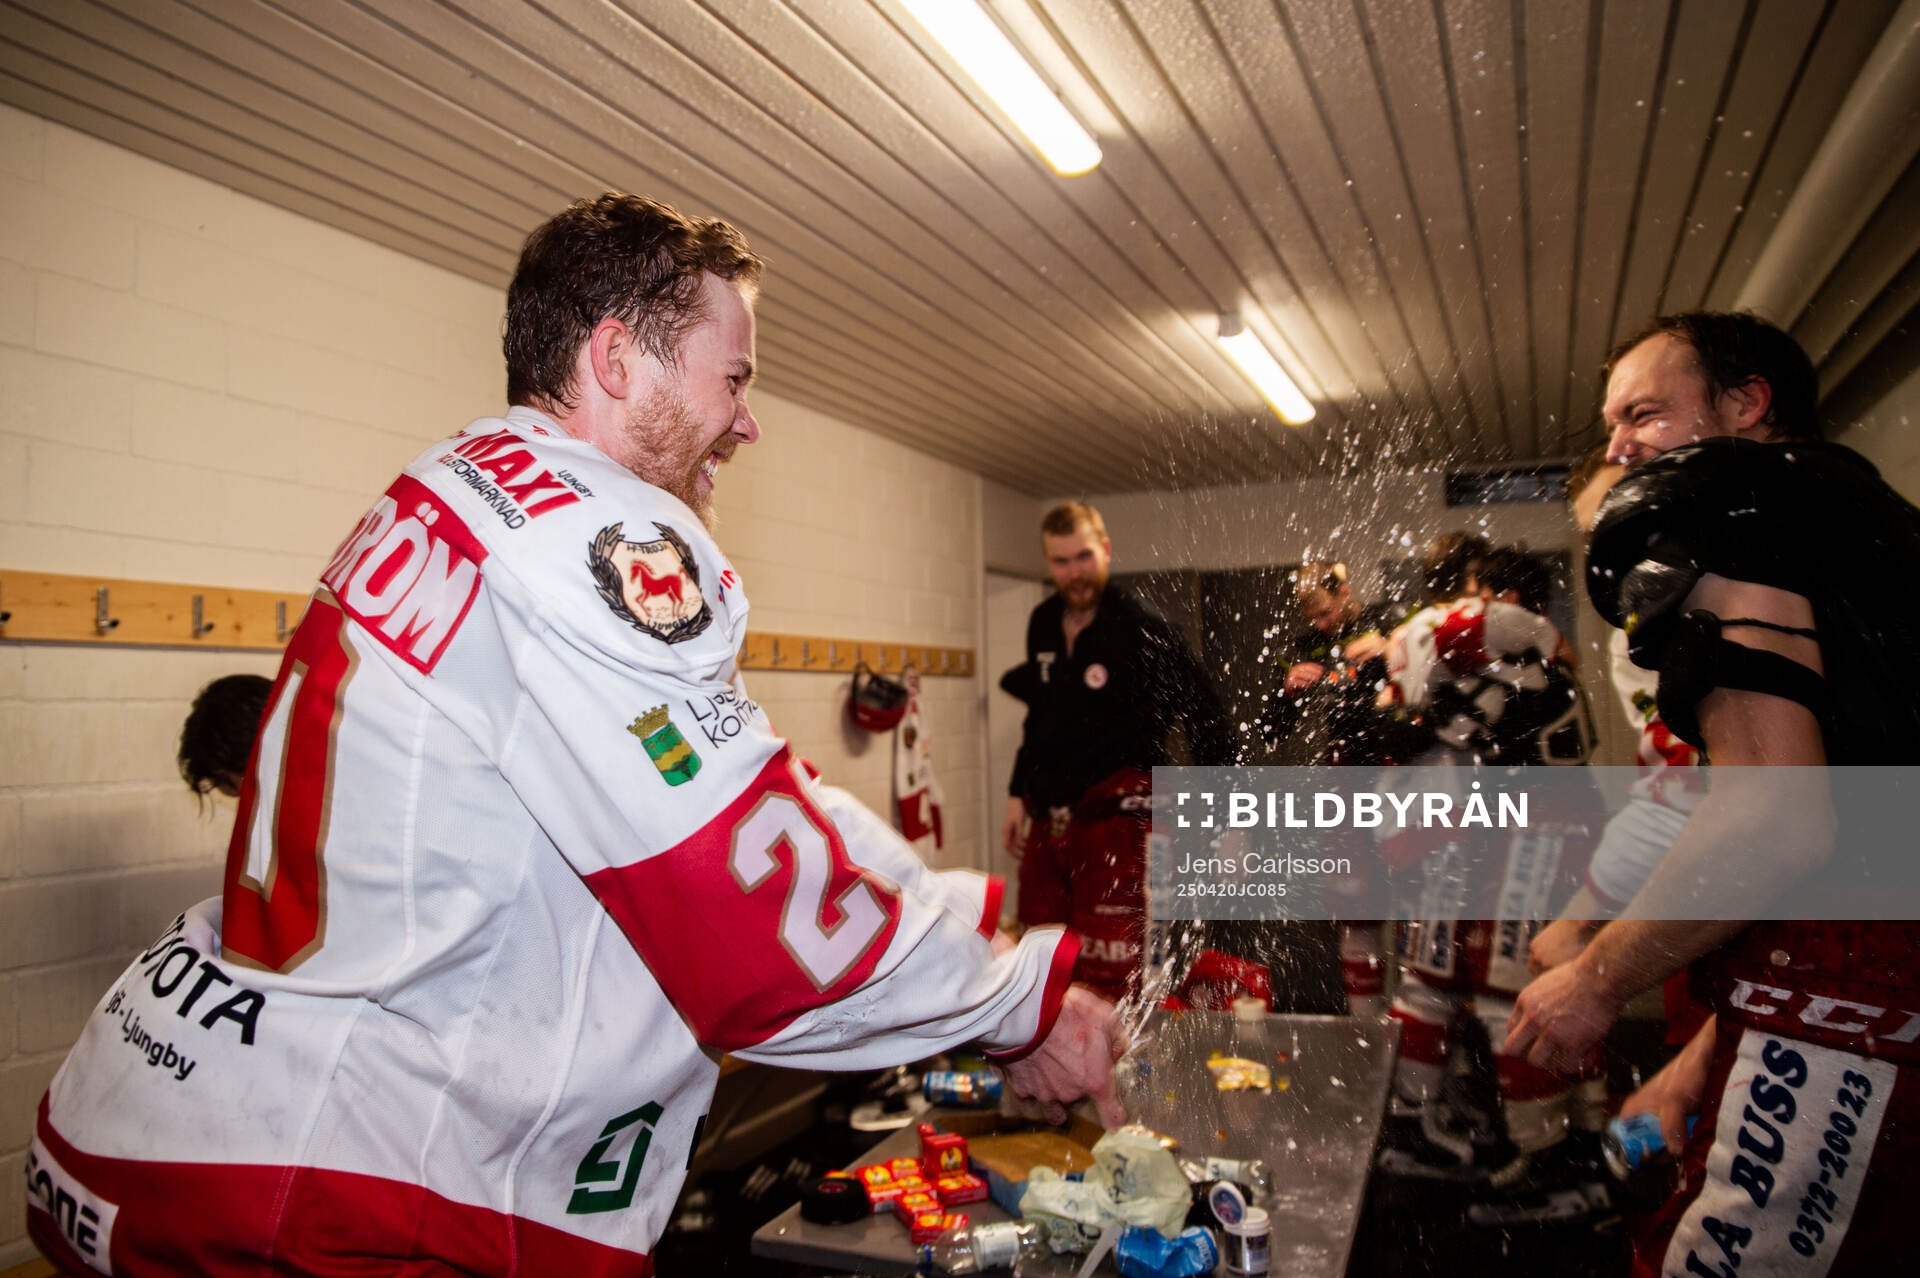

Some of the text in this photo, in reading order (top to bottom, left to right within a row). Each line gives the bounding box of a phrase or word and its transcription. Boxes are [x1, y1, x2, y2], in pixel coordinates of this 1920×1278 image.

[446, 458, 526, 530] STORMARKNAD
[454, 428, 581, 519] MAXI
[557, 469, 596, 499] LJUNGBY
[727, 790, 891, 994] 2
[121, 1008, 197, 1082] Ljungby
[1730, 1039, 1808, 1210] BUSS
